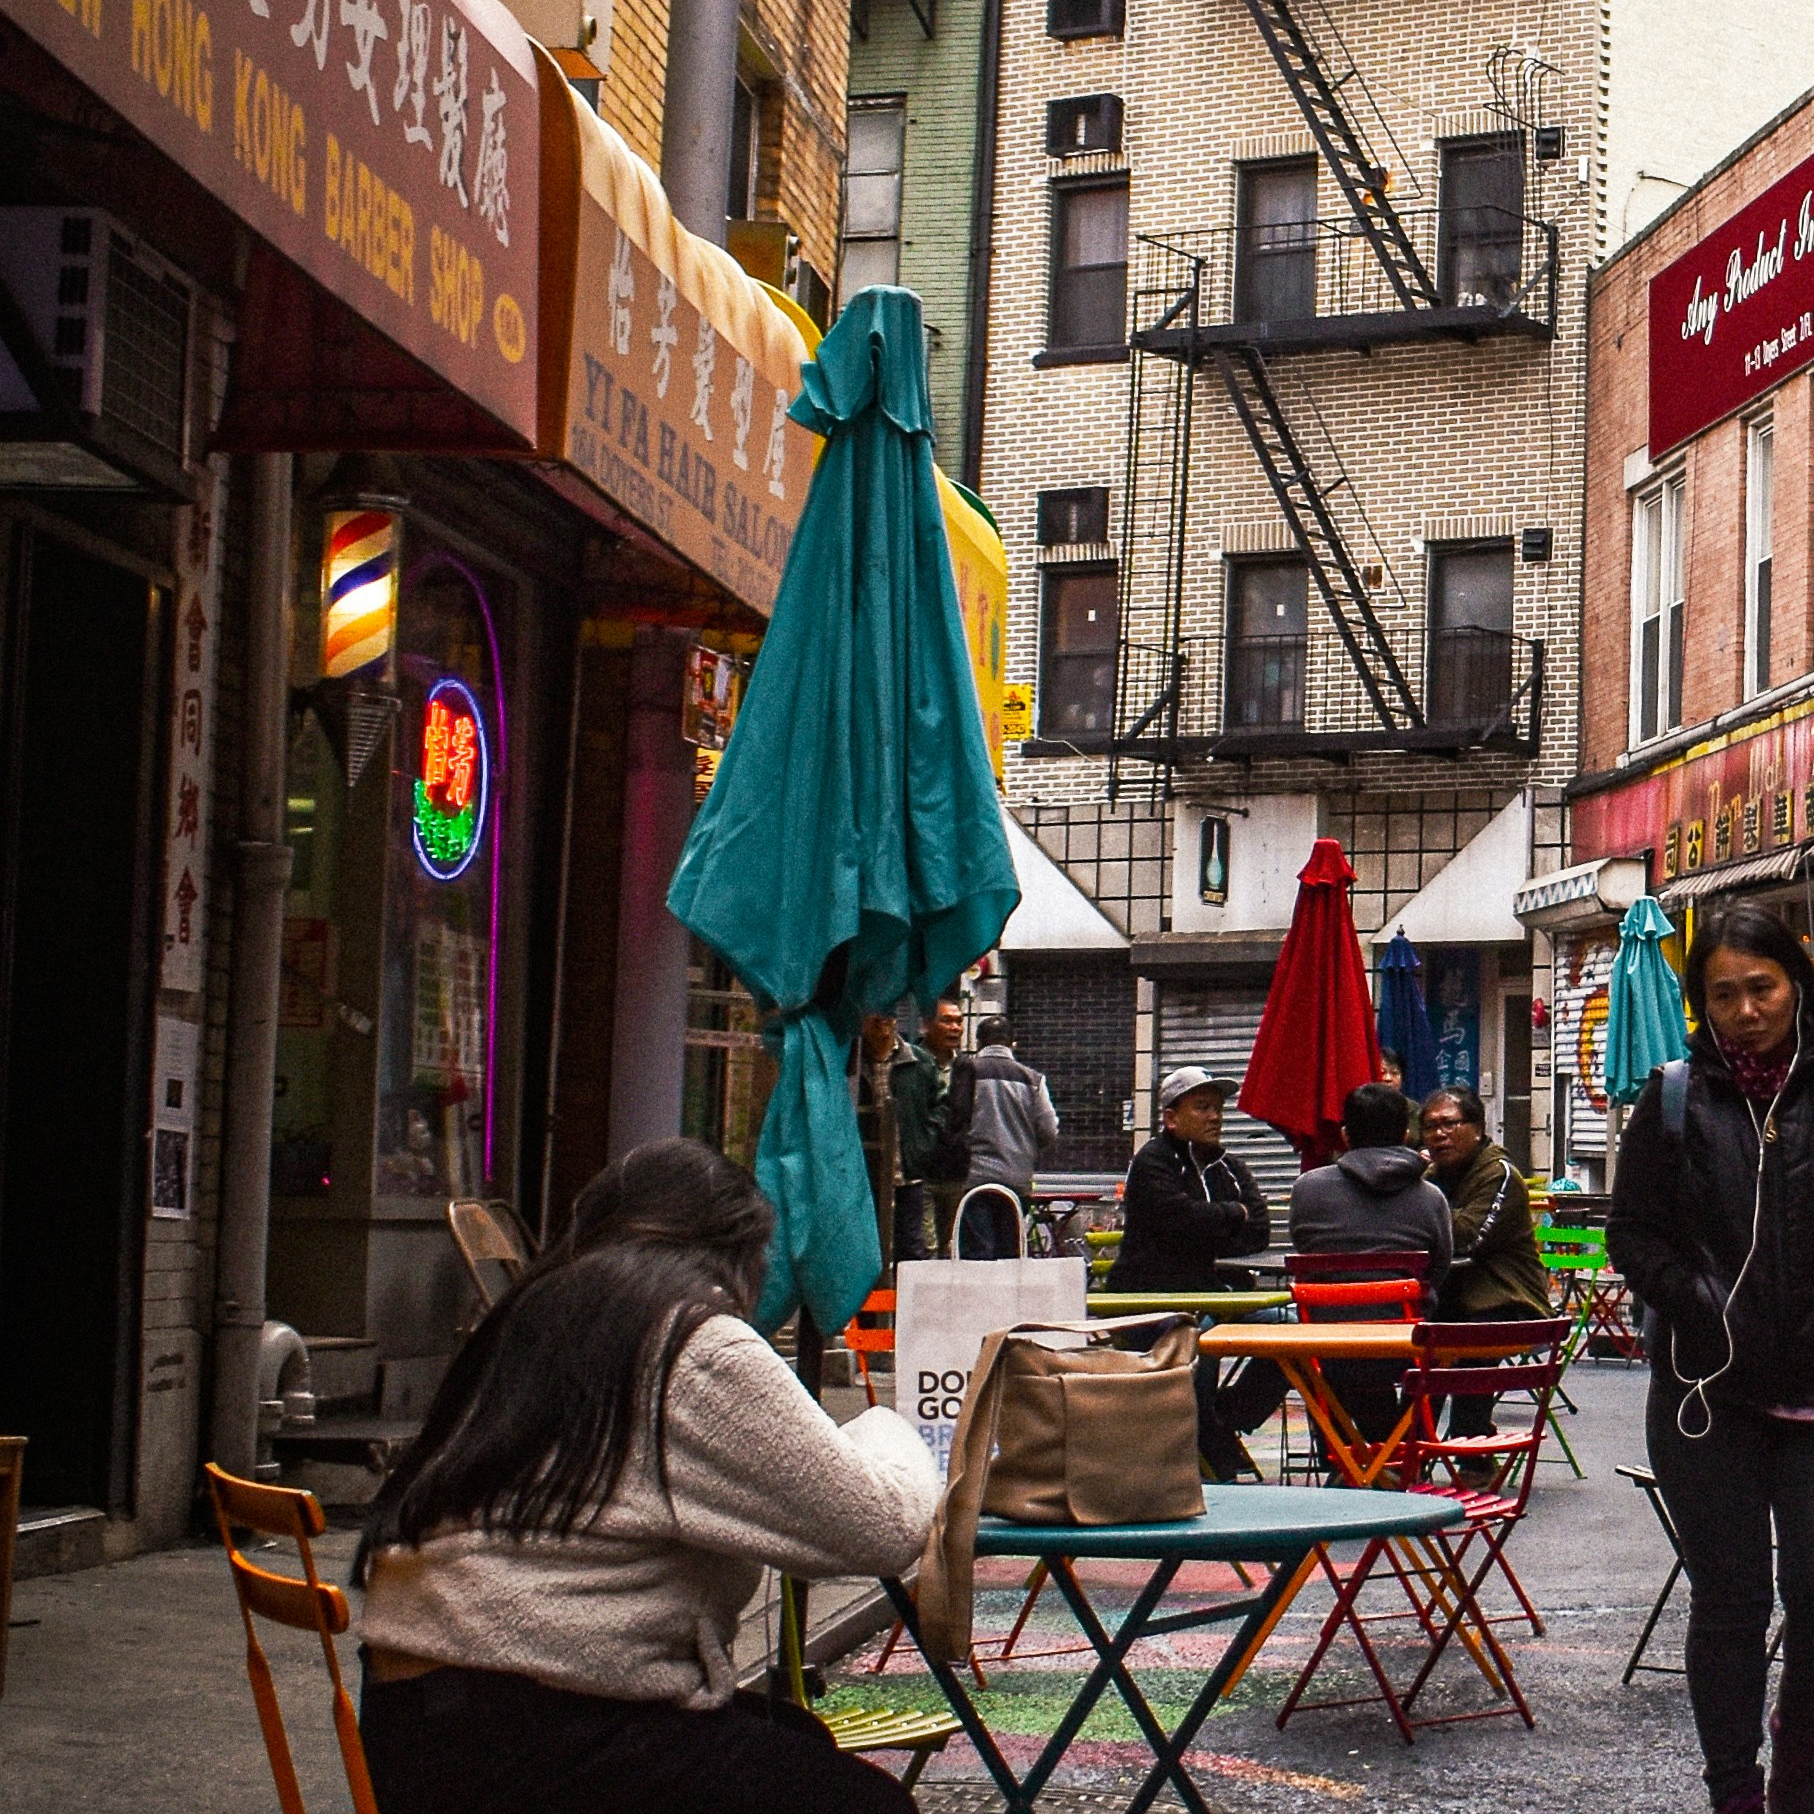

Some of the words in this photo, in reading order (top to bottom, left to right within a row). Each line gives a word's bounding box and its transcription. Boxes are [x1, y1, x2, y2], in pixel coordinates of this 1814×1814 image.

[233, 48, 307, 218] KONG
[326, 133, 413, 306] BARBER
[429, 224, 484, 349] SHOP
[1682, 275, 1718, 345] Any
[1724, 219, 1787, 312] Product
[584, 350, 613, 434] YI
[618, 386, 649, 469] FA
[656, 419, 716, 525] HAIR
[918, 1370, 972, 1394] DO
